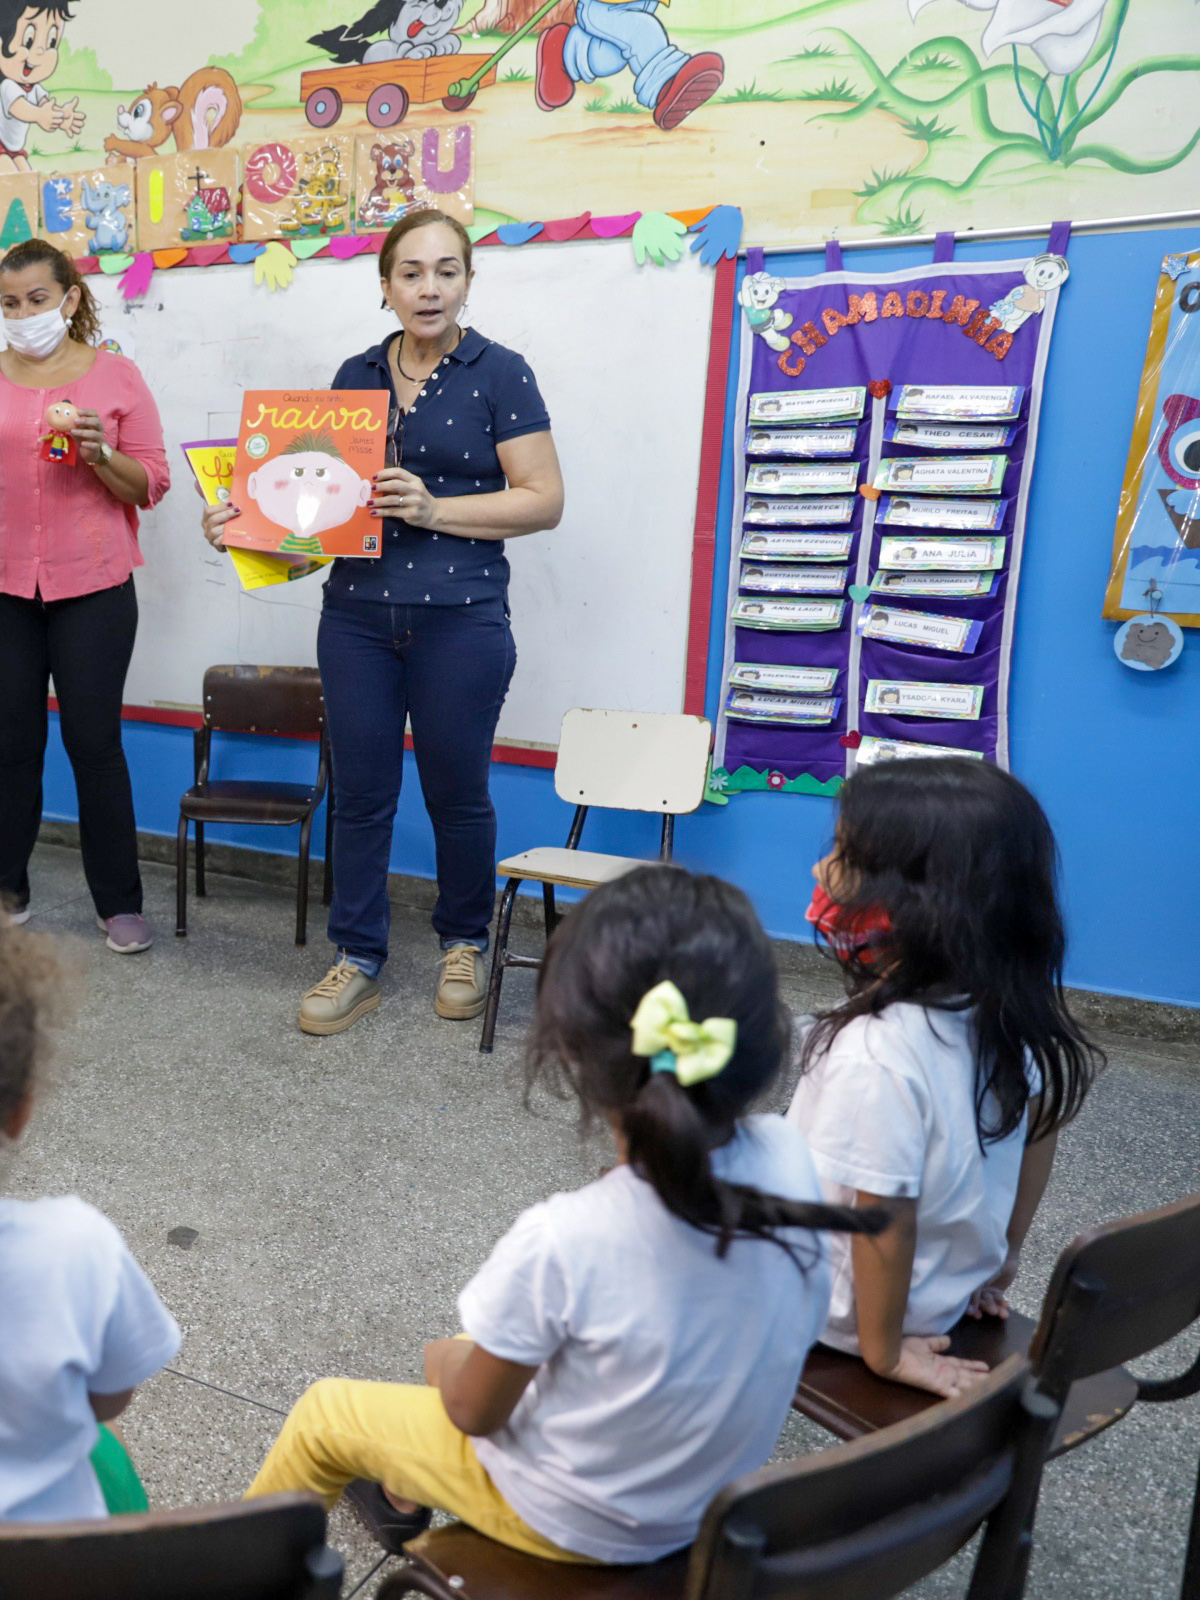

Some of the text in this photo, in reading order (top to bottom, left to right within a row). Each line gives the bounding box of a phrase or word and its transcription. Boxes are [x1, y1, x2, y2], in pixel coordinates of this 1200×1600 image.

[44, 178, 74, 232] E
[150, 169, 164, 223] I
[245, 143, 297, 204] O
[421, 124, 472, 194] U
[777, 290, 1014, 377] CHAMADINHA
[283, 393, 312, 402] Quando
[246, 403, 382, 431] raiva
[924, 430, 951, 438] THEO
[348, 435, 374, 445] James
[947, 467, 989, 475] VALENTINA
[945, 508, 979, 516] FREITAS
[921, 550, 943, 558] ANA
[894, 619, 950, 635] LUCAS MIGUEL
[757, 696, 823, 707] LUCAS MIGUEL
[940, 696, 967, 704] KYARA
